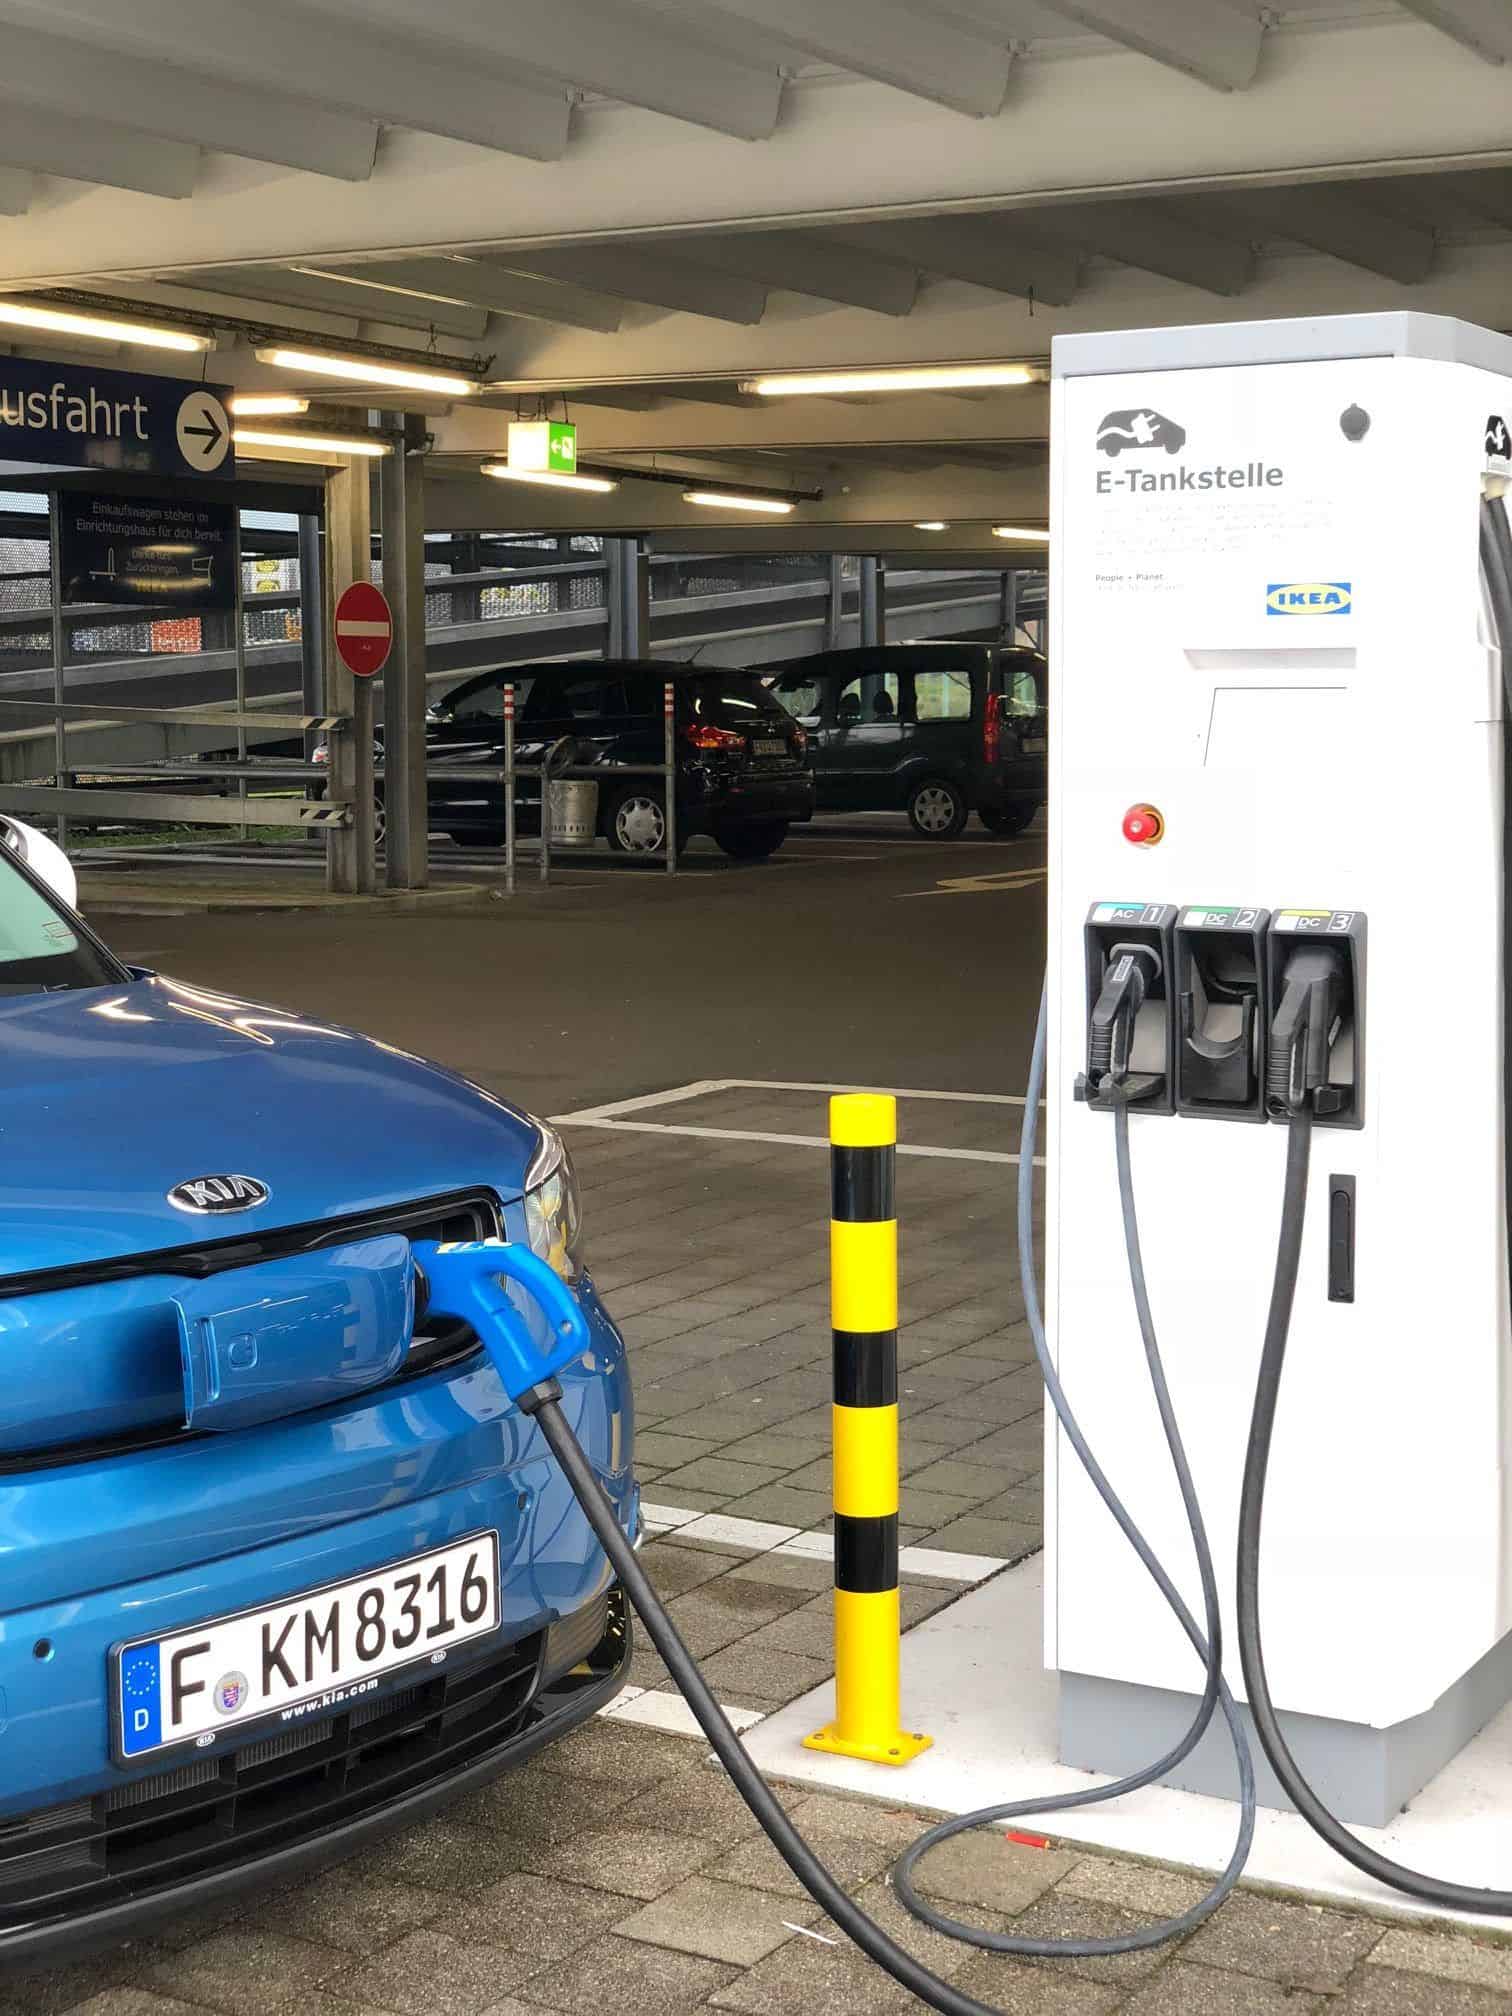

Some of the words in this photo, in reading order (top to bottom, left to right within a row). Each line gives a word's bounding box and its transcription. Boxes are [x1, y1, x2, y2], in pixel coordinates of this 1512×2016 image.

[0, 382, 149, 440] usfahrt
[1096, 462, 1284, 494] E-Tankstelle
[76, 518, 157, 537] Einrichtungshaus
[158, 524, 173, 537] für
[174, 526, 193, 539] dich
[1278, 591, 1342, 606] IKEA
[1112, 908, 1135, 920] AC
[1148, 907, 1161, 922] 1
[1206, 912, 1228, 924] DC
[1240, 910, 1255, 927] 2
[1298, 917, 1321, 928] DC
[1333, 914, 1350, 931] 3
[180, 1176, 261, 1206] KIA
[171, 1640, 211, 1725] F
[261, 1600, 340, 1696] KM
[355, 1552, 488, 1662] 8316
[281, 1677, 379, 1721] www.kia.com
[134, 1708, 149, 1732] D
